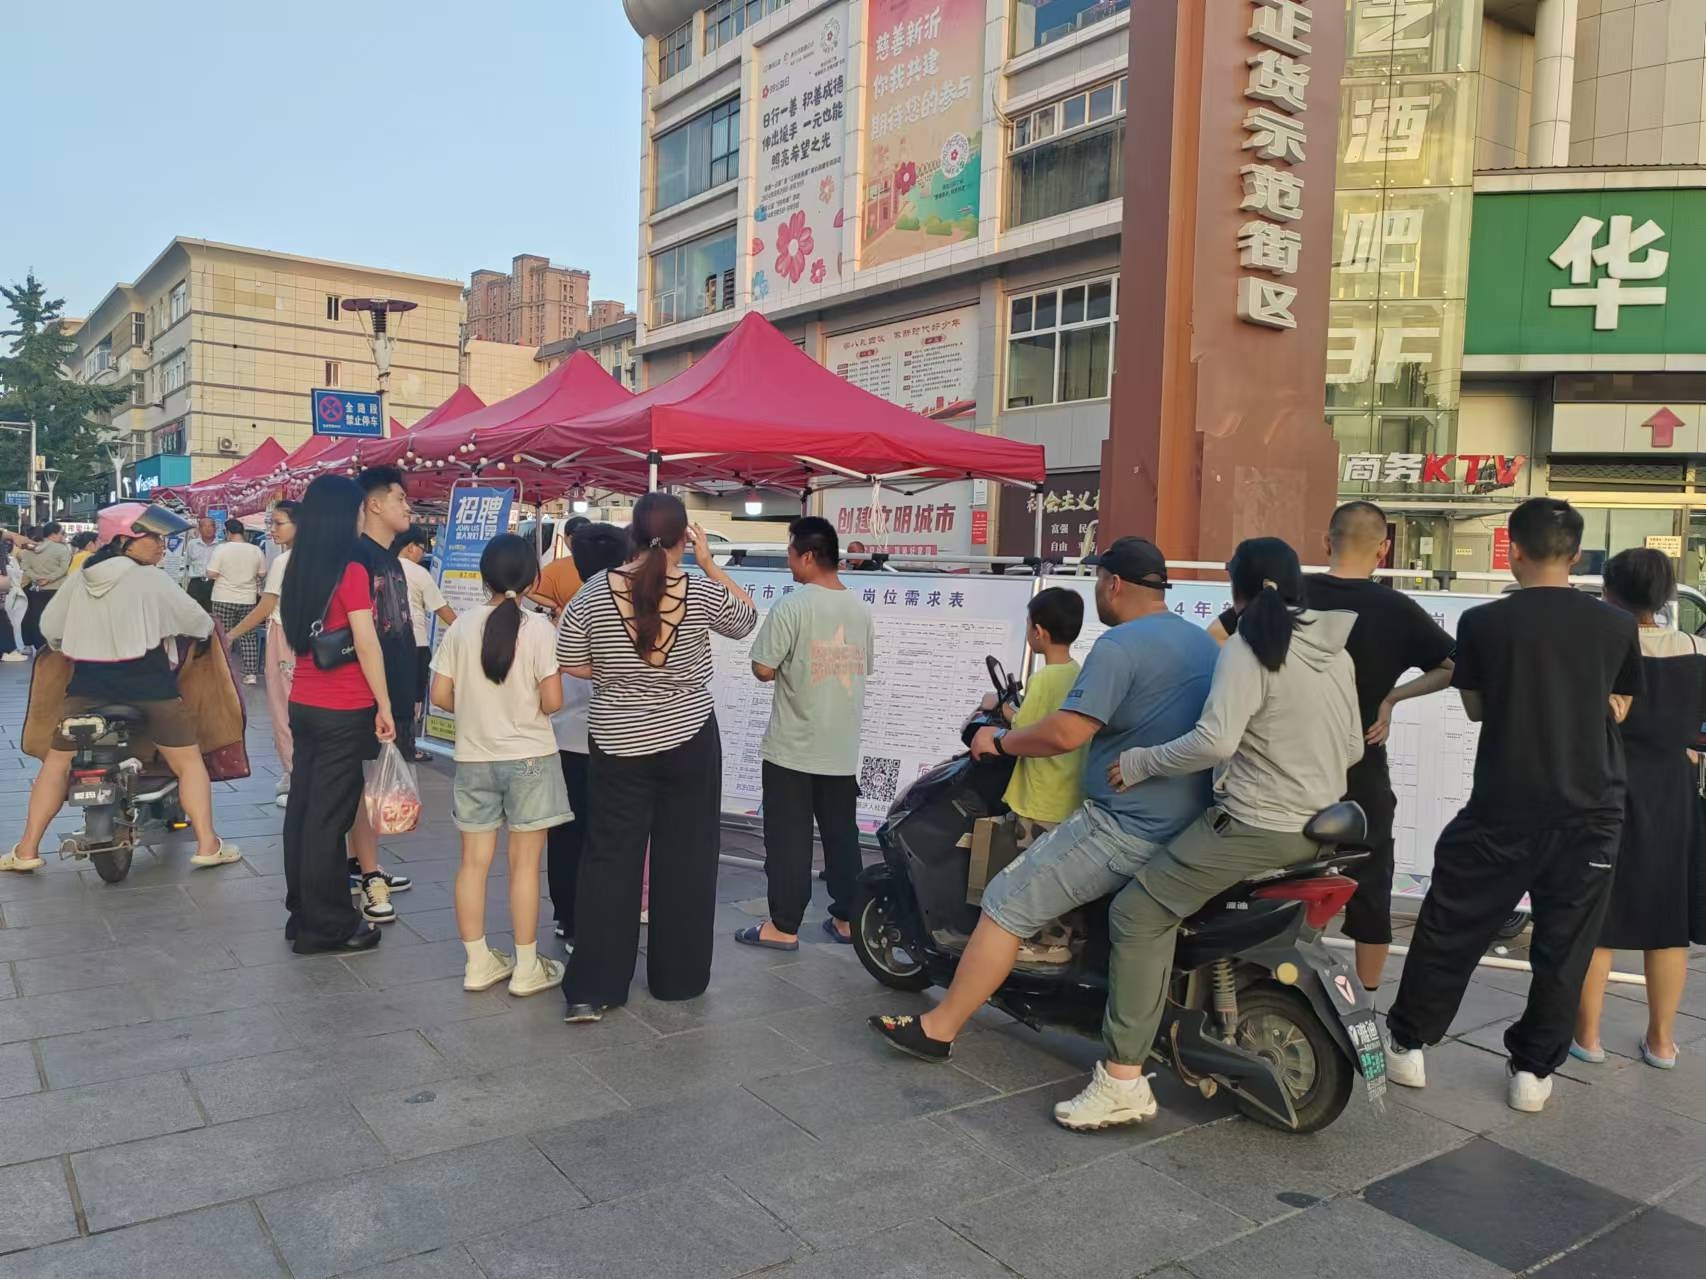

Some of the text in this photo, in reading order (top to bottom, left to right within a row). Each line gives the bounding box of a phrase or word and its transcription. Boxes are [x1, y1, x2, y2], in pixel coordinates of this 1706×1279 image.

[876, 6, 942, 60] 慈善新沂
[874, 47, 940, 99] 你我共建
[763, 75, 844, 129] 日行一善 积善成德
[871, 75, 972, 141] 期待您的参与
[762, 100, 843, 152] 伸出援手 一元也能
[770, 132, 831, 171] 照亮希望之光
[1548, 214, 1670, 331] 华
[345, 401, 378, 415] 全路段
[345, 414, 379, 427] 禁止停车
[1342, 453, 1526, 485] 商务KTV
[455, 496, 504, 540] 招聘
[838, 503, 956, 534] 创建文明城市
[1051, 523, 1069, 534] 富强
[1051, 541, 1068, 552] 自由
[862, 588, 966, 609] 岗位需求表
